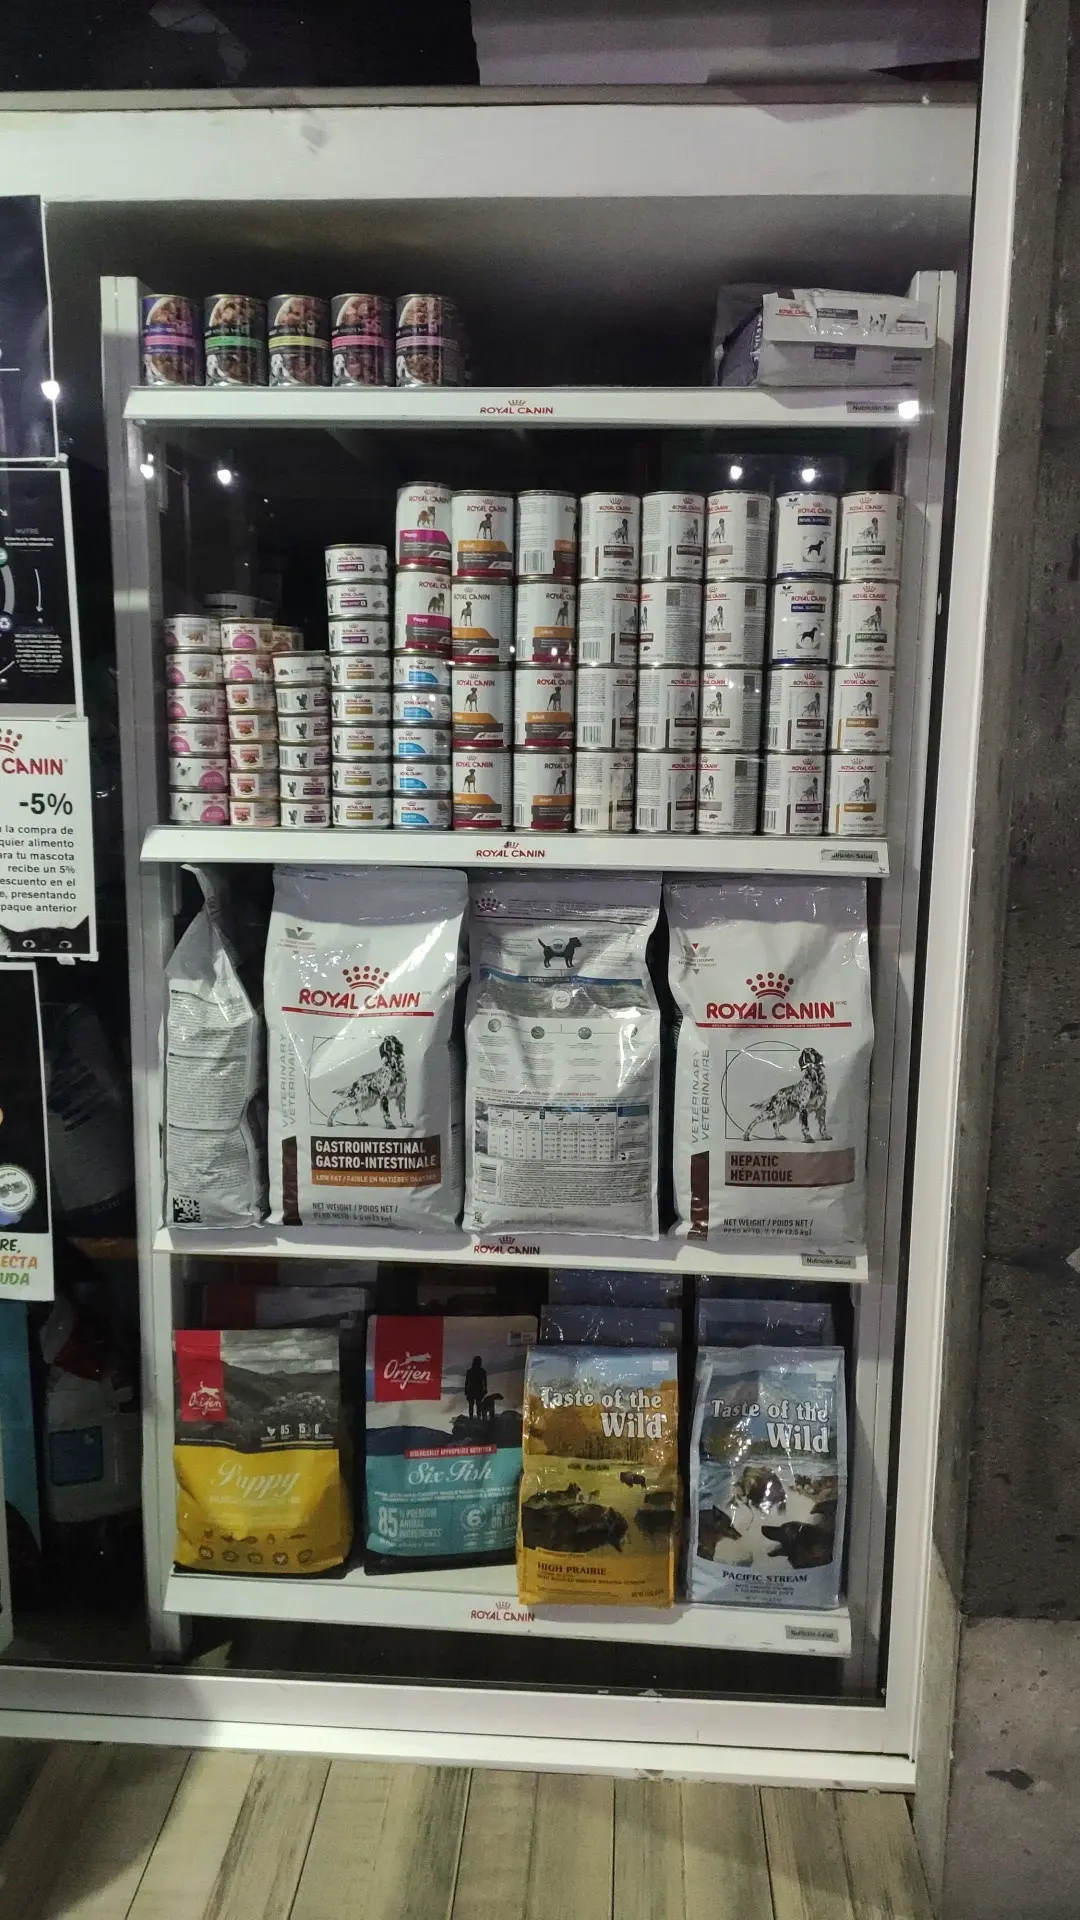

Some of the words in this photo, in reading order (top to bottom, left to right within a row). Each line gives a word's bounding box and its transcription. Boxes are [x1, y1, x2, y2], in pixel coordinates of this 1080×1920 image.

[429, 496, 449, 504] CANIN
[488, 505, 507, 513] CANIN
[418, 581, 440, 589] ROYAL
[468, 593, 491, 601] CANIN
[2, 758, 64, 775] CANIN
[472, 761, 494, 769] CANIN
[19, 793, 73, 815] -5%
[5, 825, 15, 833] la
[18, 826, 57, 836] compra
[60, 826, 74, 834] de
[28, 838, 74, 848] alimento
[16, 851, 27, 860] tu
[30, 852, 75, 861] mascota
[476, 849, 509, 858] ROYAL
[511, 850, 546, 858] CANIN
[7, 864, 40, 873] recibe
[43, 865, 56, 873] un
[59, 865, 76, 874] 5%
[50, 878, 63, 886] en
[66, 877, 76, 886] el
[11, 890, 77, 900] presentando
[1, 904, 33, 914] paque
[35, 903, 77, 912] anterior
[298, 988, 359, 1010] ROYAL
[364, 991, 421, 1010] CANIN
[706, 1002, 768, 1020] ROYAL
[771, 1001, 835, 1020] CANIN
[315, 1140, 426, 1154] GASTROINTESTINAL
[315, 1154, 437, 1169] GASTRO-INTESTINALE
[730, 1155, 779, 1167] HEPATIC
[347, 1175, 368, 1183] FAIBLE
[730, 1168, 793, 1182] HÉPATIQUE
[313, 1202, 324, 1210] NET
[326, 1203, 352, 1212] WEIGHT
[359, 1204, 379, 1213] POIDS
[381, 1205, 393, 1213] NET
[723, 1218, 737, 1226] NET
[738, 1218, 766, 1227] WEIGHT
[772, 1219, 794, 1227] POIDS
[795, 1219, 809, 1227] NET
[473, 1245, 505, 1254] ROYAL
[507, 1245, 540, 1255] CANIN
[1, 1255, 38, 1270] ECTA
[384, 1360, 432, 1391] Orijen
[539, 1386, 595, 1409] Taste
[602, 1388, 624, 1409] of
[630, 1389, 662, 1410] the
[711, 1399, 760, 1418] Taste
[767, 1400, 789, 1419] of
[796, 1401, 830, 1422] the
[600, 1412, 663, 1439] Wild
[766, 1422, 830, 1453] Wild
[408, 1462, 445, 1486] Six
[446, 1460, 493, 1483] Fish
[378, 1506, 398, 1538] 85
[466, 1508, 482, 1527] 6
[537, 1562, 563, 1573] HIGH
[566, 1566, 607, 1576] PRAIRIE
[722, 1570, 762, 1582] PACIFIC
[765, 1574, 809, 1583] STREAM
[470, 1609, 502, 1621] ROYAL
[503, 1612, 535, 1622] CANIN
